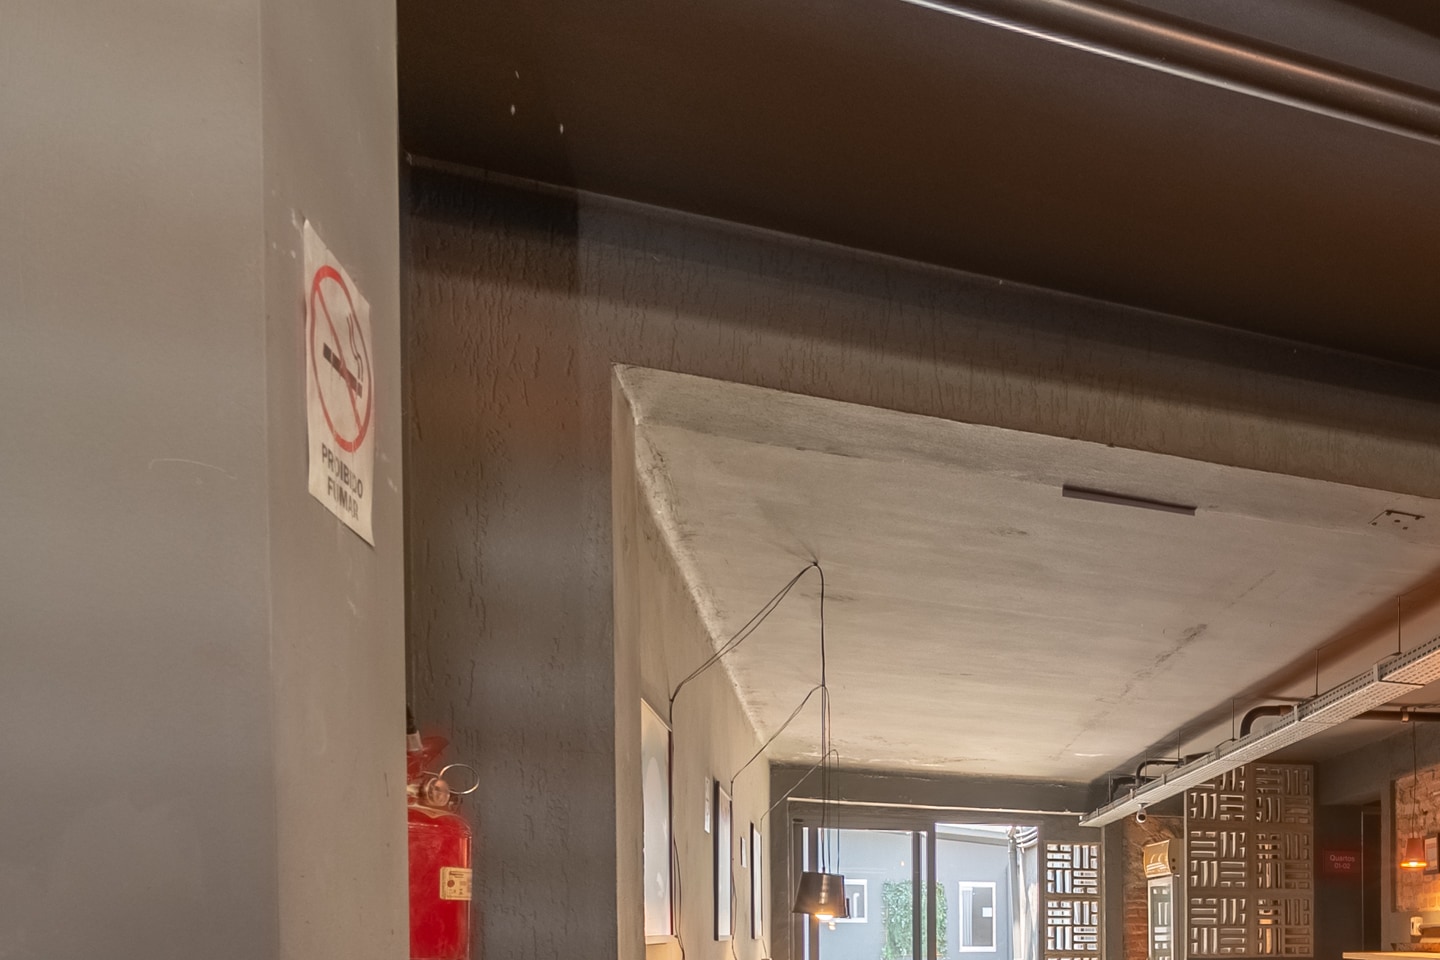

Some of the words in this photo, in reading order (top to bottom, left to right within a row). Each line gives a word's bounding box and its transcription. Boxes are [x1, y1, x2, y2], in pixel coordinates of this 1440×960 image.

[322, 442, 363, 499] PROIBIDO
[328, 476, 359, 521] FUMAR
[1329, 854, 1355, 862] Quartos
